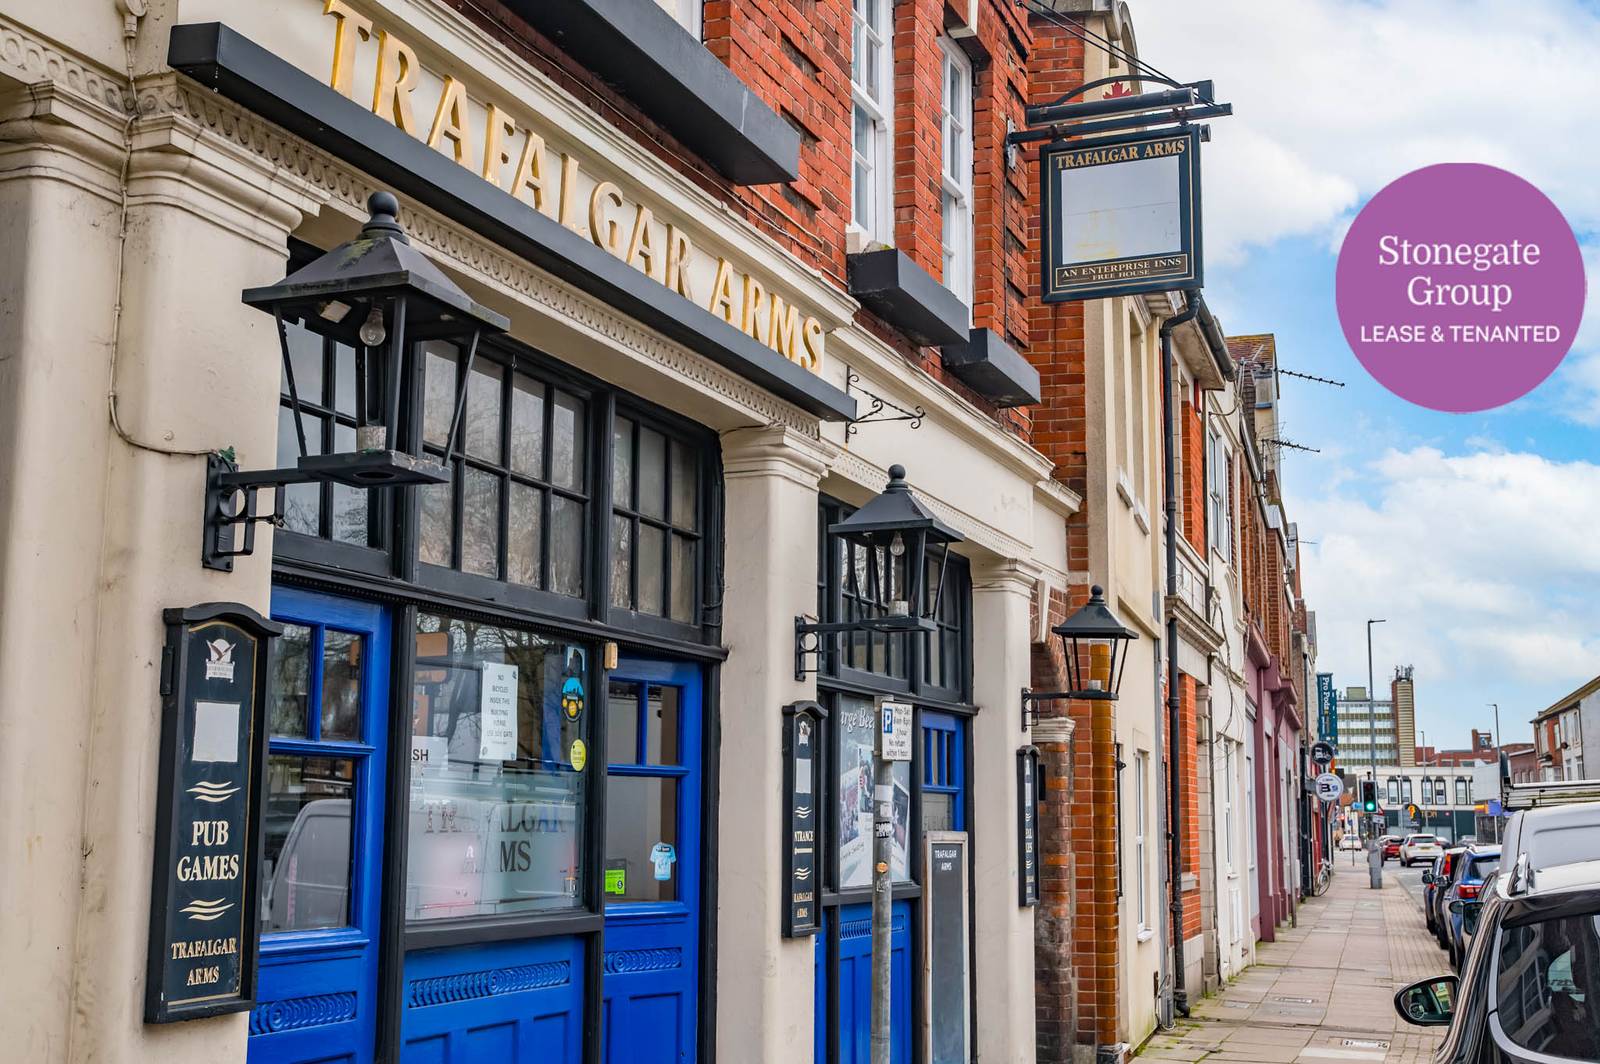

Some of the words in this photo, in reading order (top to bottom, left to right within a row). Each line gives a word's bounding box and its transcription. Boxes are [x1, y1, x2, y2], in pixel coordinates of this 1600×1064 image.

[1056, 146, 1139, 169] TRAFALGAR
[1144, 139, 1185, 158] ARMS
[323, 0, 694, 302] TRAFALGAR
[709, 256, 826, 375] ARMS
[1062, 268, 1078, 278] AN
[1082, 259, 1151, 276] ENTERPRISE
[1154, 257, 1182, 268] INNS
[1092, 272, 1116, 281] FREE
[1119, 269, 1150, 279] HOUSE
[840, 711, 857, 733] arge
[859, 708, 875, 729] Bee
[411, 748, 429, 762] SH
[191, 820, 229, 846] PUB
[794, 830, 814, 842] NTRANCE
[934, 849, 957, 859] TRAFALGAR
[176, 854, 239, 882] GAMES
[941, 862, 952, 871] ARMS
[171, 937, 237, 960] TRAFALGAR
[186, 965, 220, 987] ARMS
